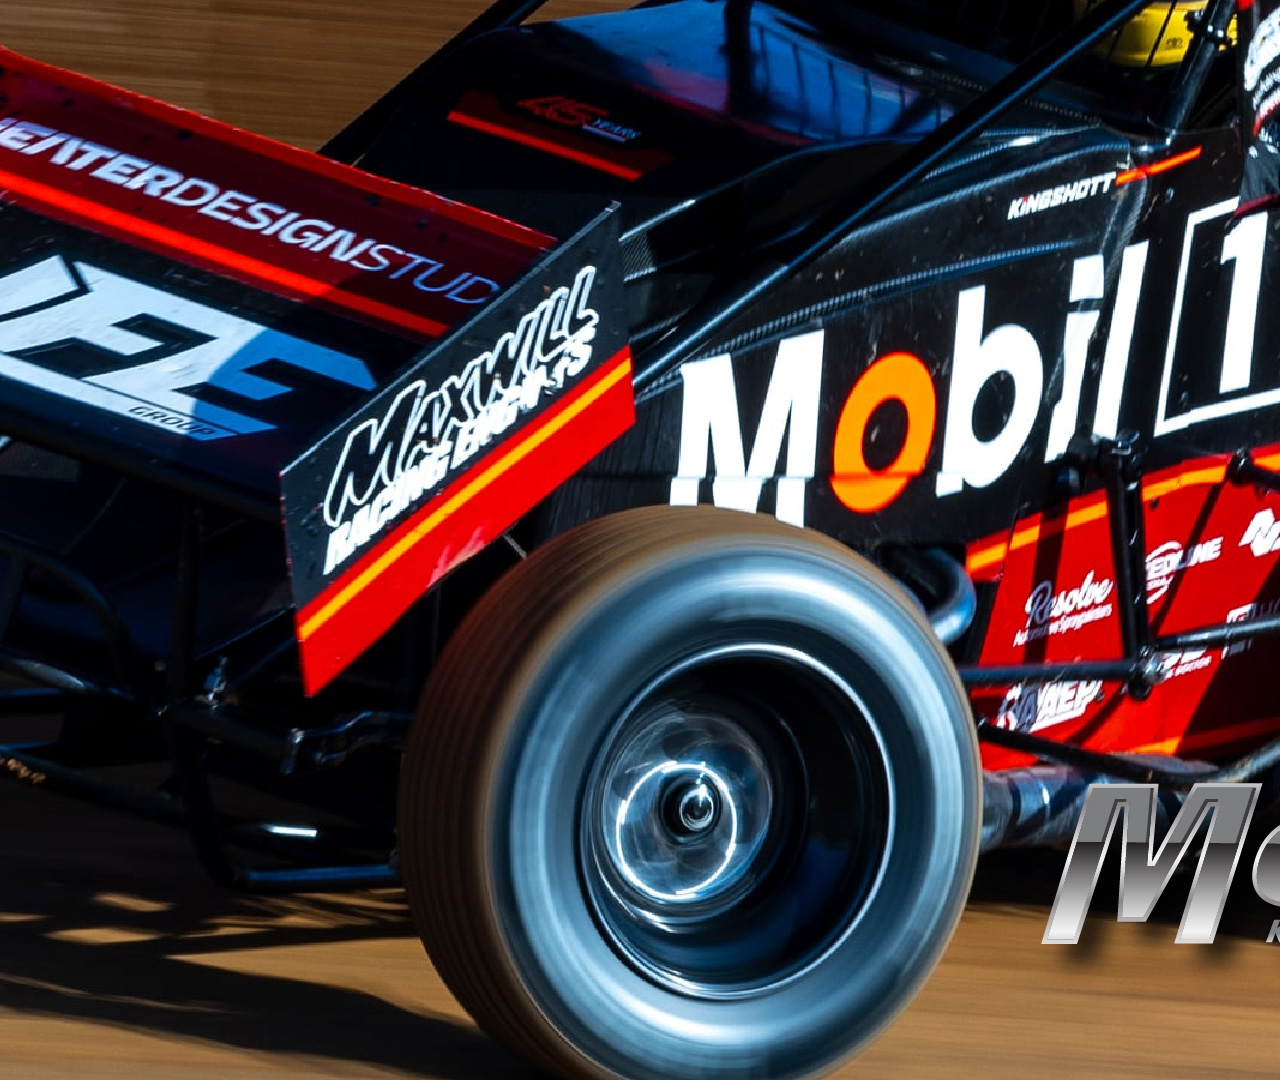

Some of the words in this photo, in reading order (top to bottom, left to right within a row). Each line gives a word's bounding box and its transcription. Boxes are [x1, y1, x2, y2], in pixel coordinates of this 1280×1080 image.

[670, 239, 1151, 527] Mobil
[1219, 211, 1269, 395] 1
[323, 453, 451, 575] RACING
[1026, 568, 1114, 628] Resolve
